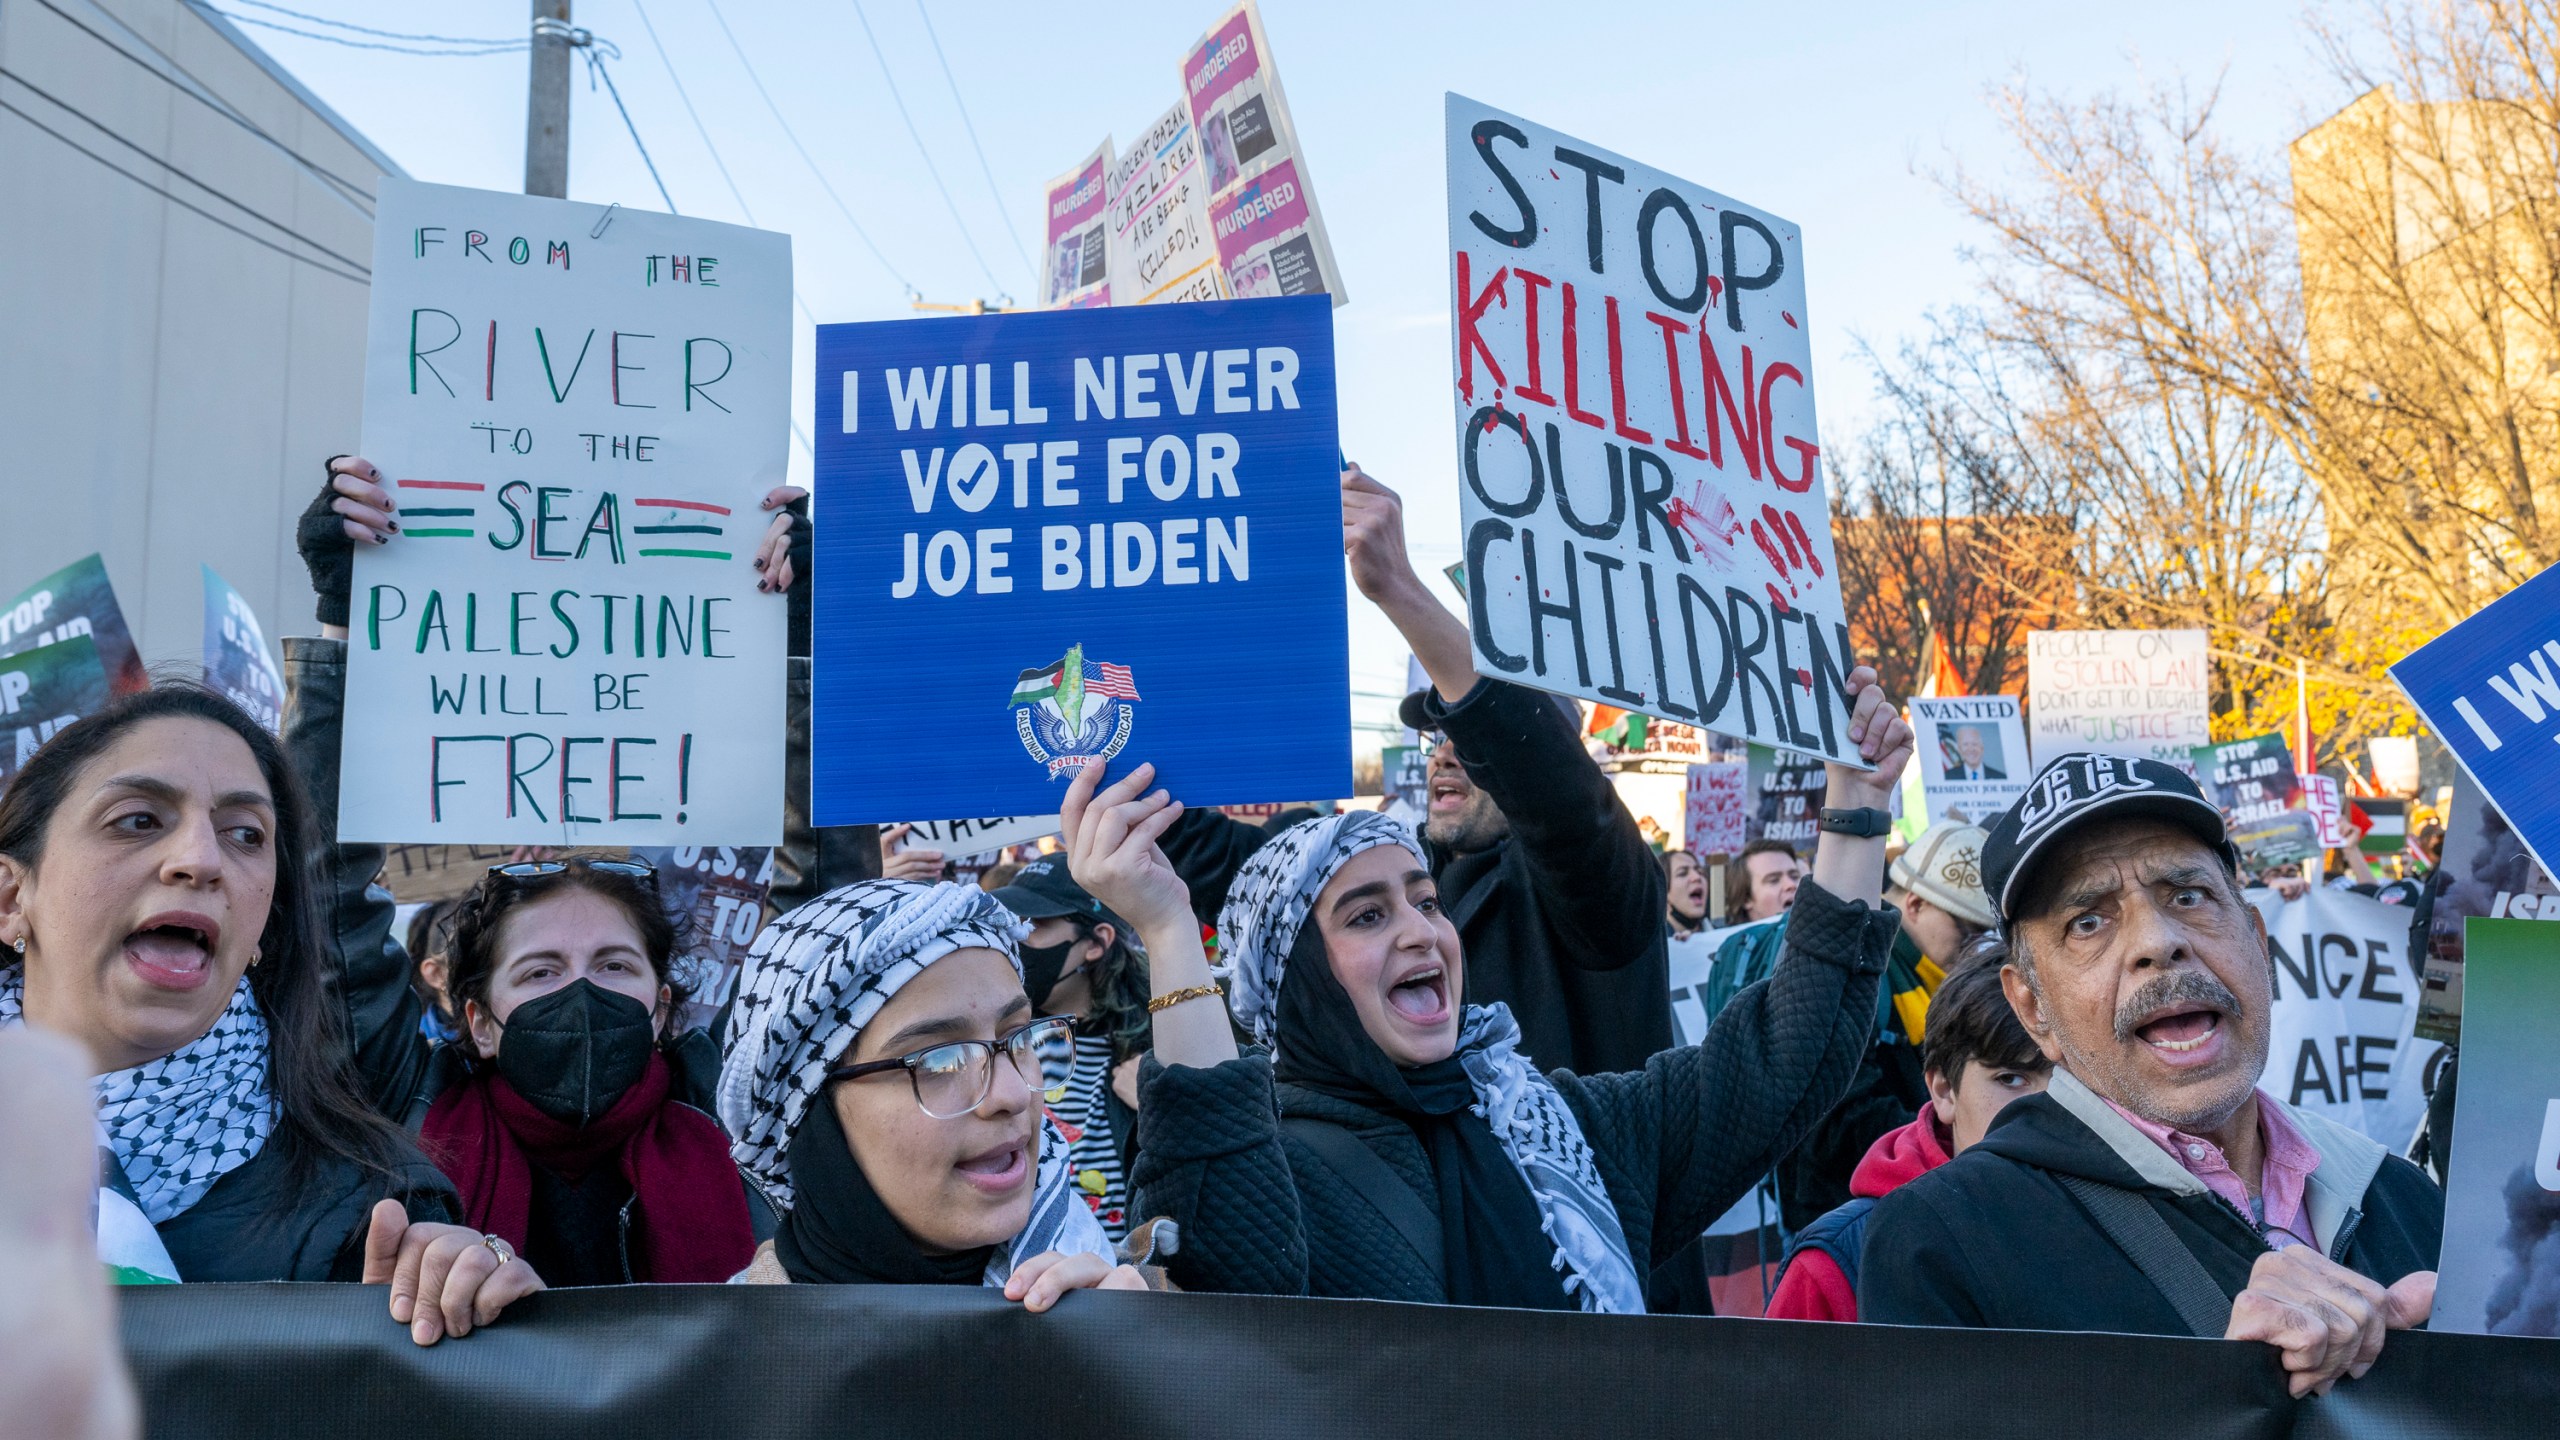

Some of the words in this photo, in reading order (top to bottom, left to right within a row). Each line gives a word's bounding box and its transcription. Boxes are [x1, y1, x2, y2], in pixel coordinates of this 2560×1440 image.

[1189, 32, 1248, 97] MURDERED
[1106, 138, 1151, 206] INNOCENT
[1152, 101, 1186, 152] GAZAN
[1053, 174, 1102, 219] MURDERED
[1115, 134, 1195, 234] CHILDREN
[1215, 181, 1296, 240] MURDERED
[1133, 216, 1154, 252] ARE
[1156, 184, 1190, 227] BEING
[1469, 119, 1784, 333] STOP
[415, 226, 570, 271] FROM
[645, 254, 721, 287] THE
[410, 307, 733, 414] RIVER
[1457, 250, 1820, 494] KILLING
[842, 370, 859, 434] I
[885, 360, 1048, 431] WILL
[1073, 346, 1301, 422] NEVER
[470, 423, 533, 455] TO
[578, 433, 661, 462] THE
[900, 434, 1080, 514] VOTE
[1107, 432, 1241, 504] FOR
[1464, 406, 1693, 565] OUR
[488, 480, 626, 564] SEA
[891, 527, 1013, 599] JOE
[1041, 515, 1249, 592] BIDEN
[367, 583, 736, 660] PALESTINE
[1467, 517, 1877, 767] CHILDREN
[2035, 631, 2113, 657] PEOPLE
[2137, 632, 2174, 659] ON
[430, 672, 569, 716] WILL
[593, 673, 650, 713] BE
[2053, 658, 2138, 690] STOLEN
[2085, 689, 2113, 709] GET
[2120, 689, 2140, 708] TO
[1017, 708, 1049, 763] PALESTINIAN
[1100, 705, 1132, 762] AMERICAN
[1918, 701, 2015, 719] WANTED
[2039, 714, 2083, 735] WHAT
[2082, 711, 2182, 743] JUSTICE
[2185, 714, 2207, 737] IS
[2451, 695, 2503, 752] I
[431, 732, 693, 826] FREE!
[1763, 771, 1797, 792] U.S.
[1800, 769, 1827, 791] AID
[2213, 764, 2248, 785] U.S.
[2250, 756, 2280, 779] AID
[2215, 740, 2259, 764] STOP
[1783, 796, 1806, 817] TO
[1926, 784, 1979, 795] PRESIDENT
[1982, 784, 1998, 794] JOE
[2237, 781, 2264, 801] TO
[1763, 819, 1820, 840] ISRAEL
[710, 895, 761, 947] TO
